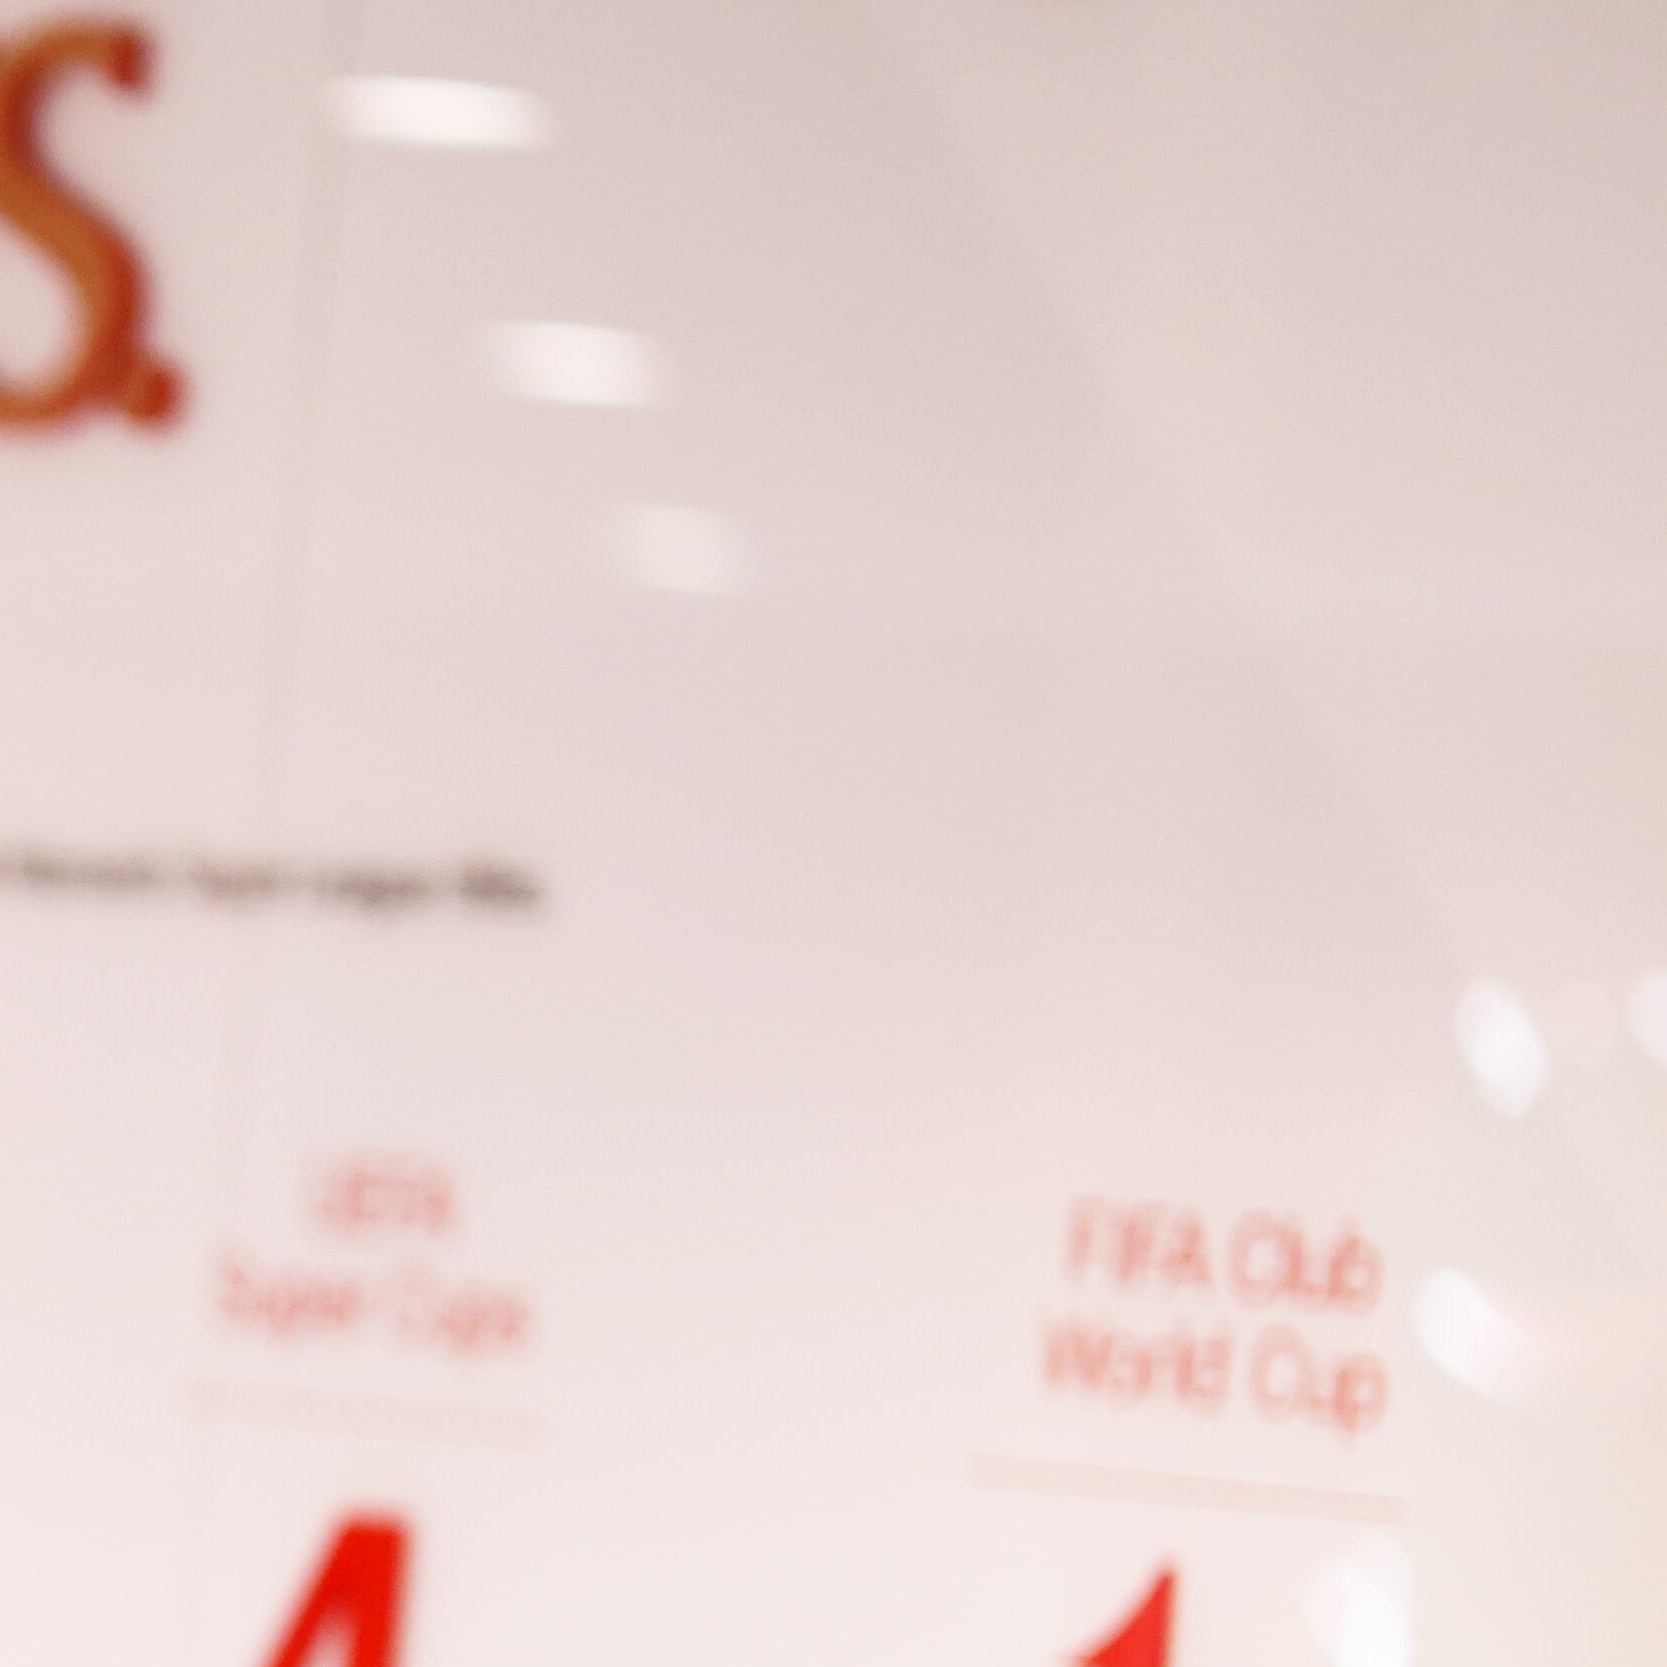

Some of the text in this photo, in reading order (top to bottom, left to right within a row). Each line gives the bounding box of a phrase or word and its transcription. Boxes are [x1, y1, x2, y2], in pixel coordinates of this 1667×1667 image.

[1224, 1206, 1387, 1312] Club
[1037, 1306, 1390, 1442] World Cup
